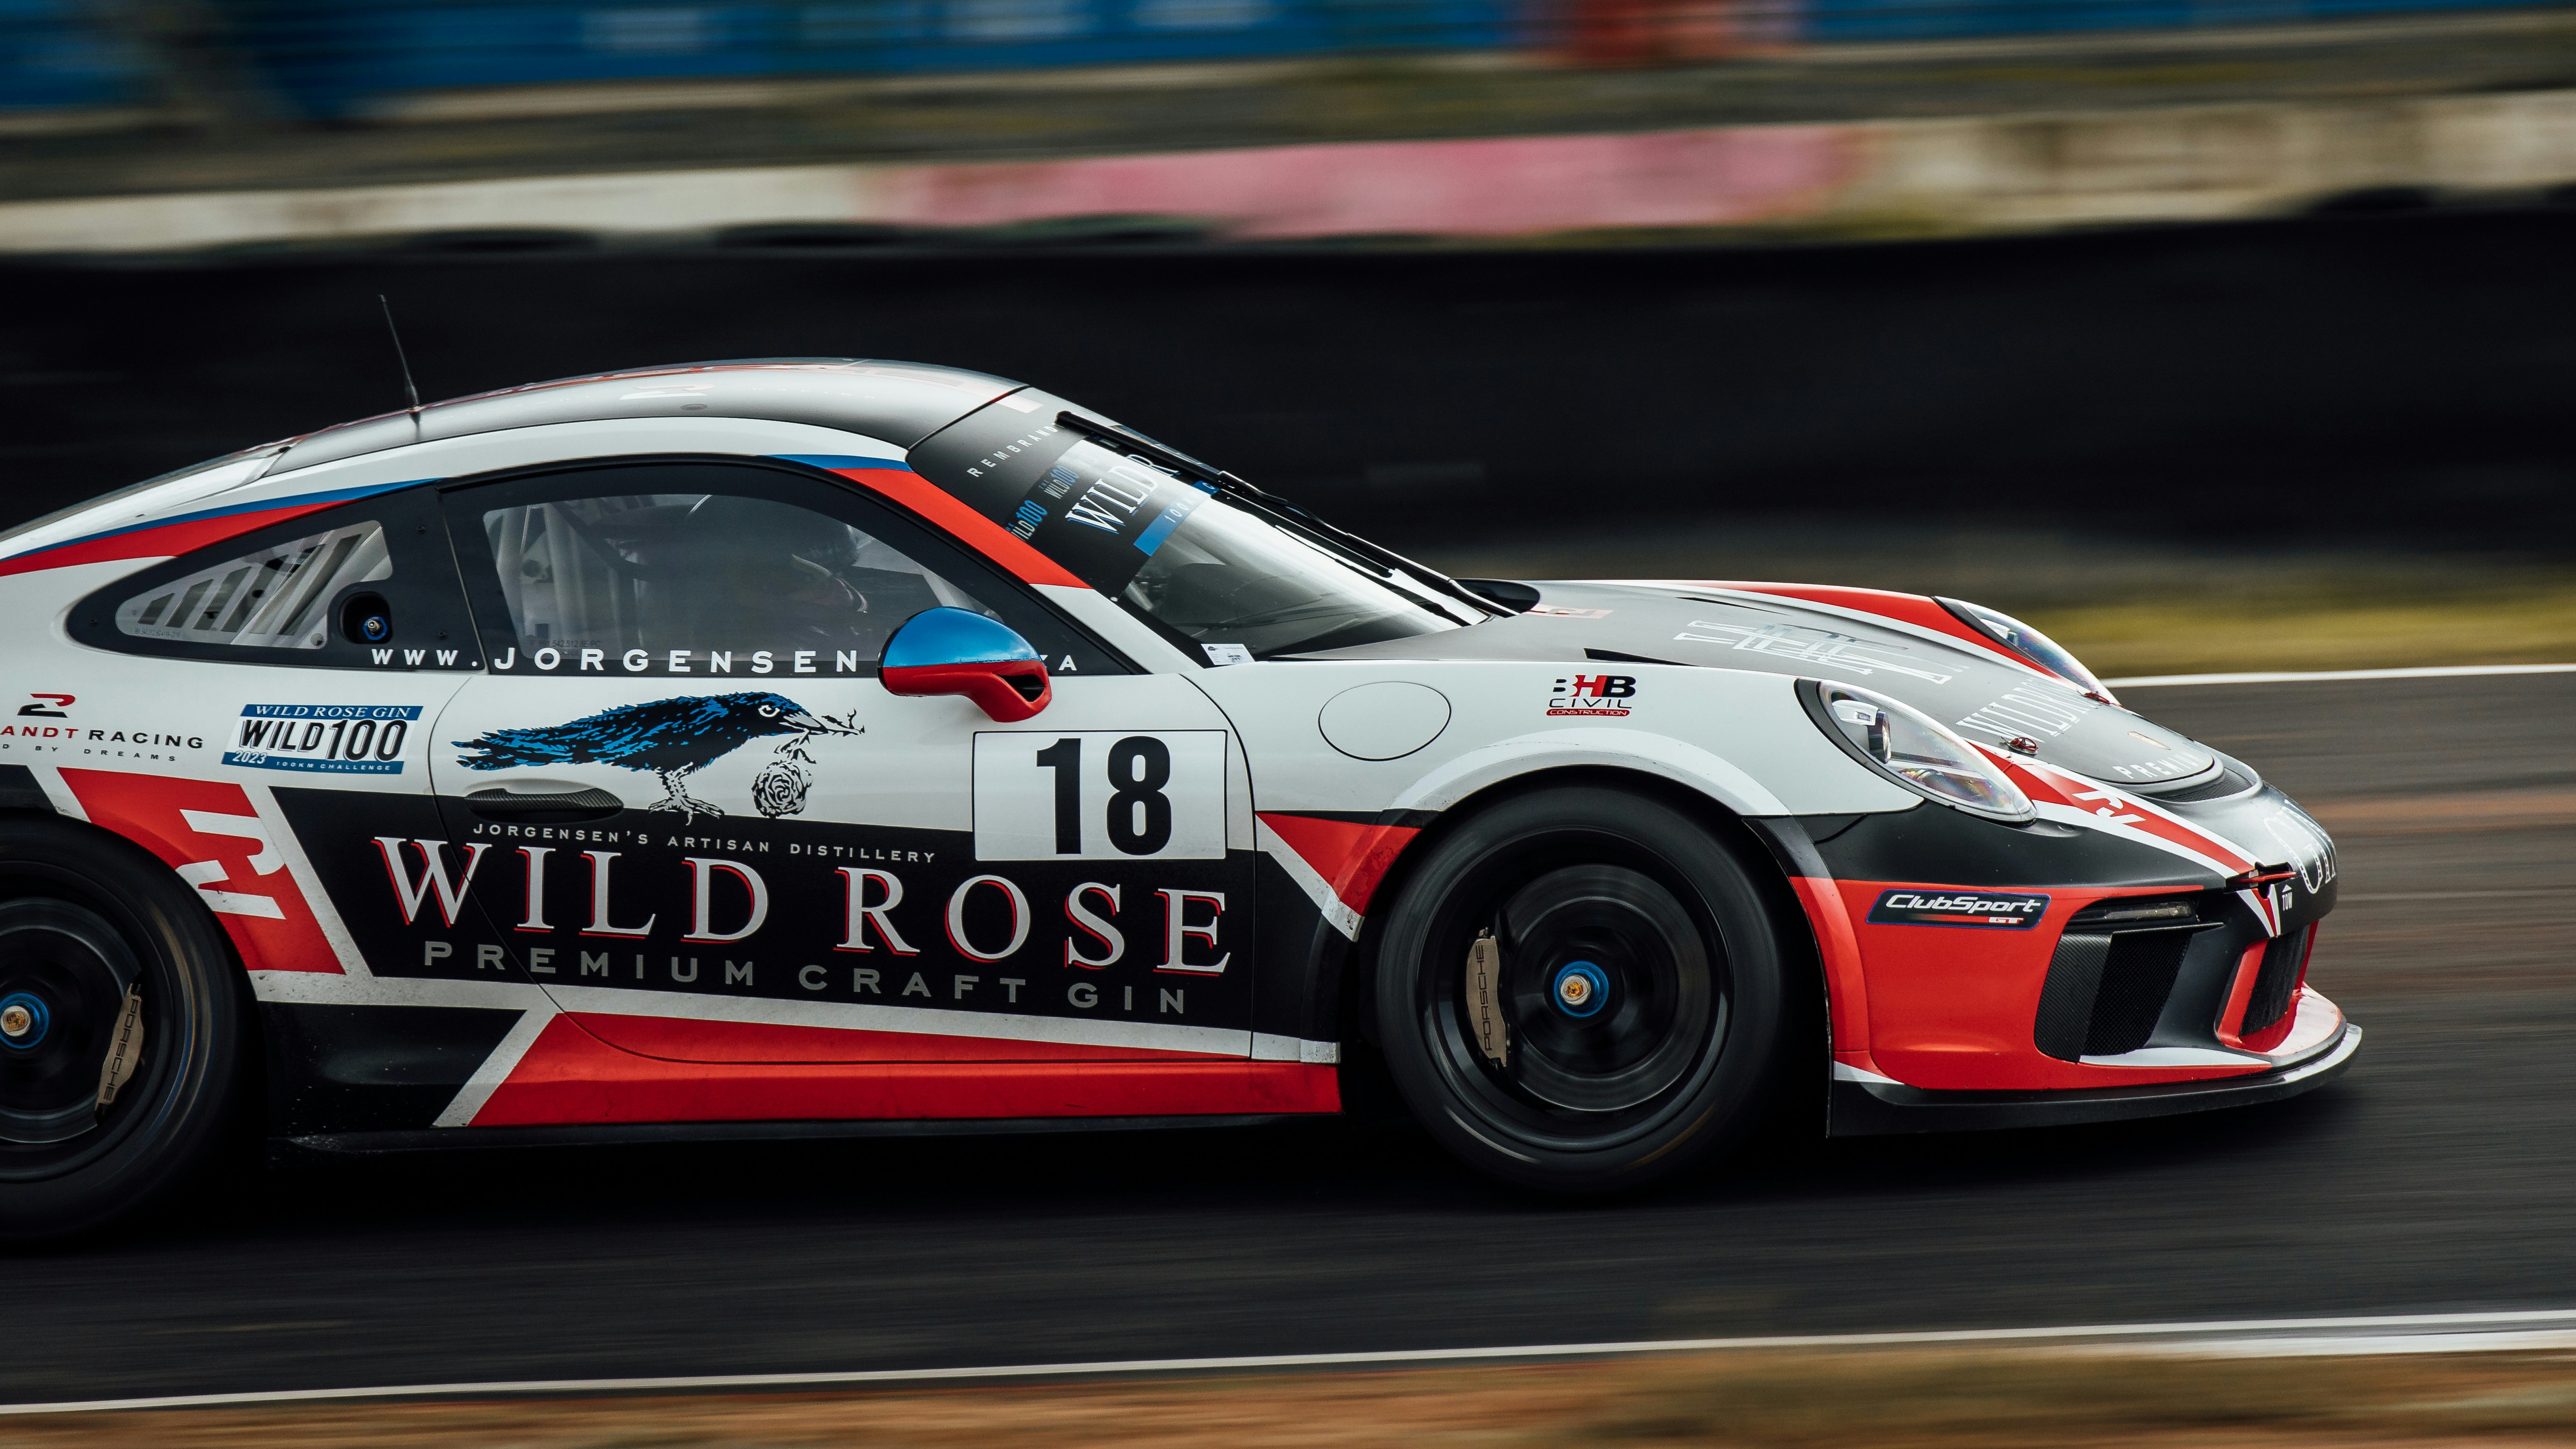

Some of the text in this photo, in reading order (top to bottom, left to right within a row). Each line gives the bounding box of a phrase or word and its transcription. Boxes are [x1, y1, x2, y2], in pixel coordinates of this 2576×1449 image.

[967, 423, 1059, 477] REMBRAND
[1065, 466, 1158, 534] WILD
[255, 706, 412, 718] WILD ROSE GIN
[1549, 698, 1632, 709] CIVIL
[88, 729, 203, 749] RACING
[83, 749, 175, 762] DREAMS
[232, 750, 268, 764] 2023
[1036, 735, 1172, 856] 18
[473, 823, 935, 863] JORGENSEN'S ARTISAN DISTILLERY
[371, 837, 1231, 976] WILD ROSE
[1886, 894, 2041, 914] ClubSport
[2282, 892, 2292, 911] TOW
[424, 941, 1183, 1014] PREMIUM CRAFT GIN
[1475, 944, 1493, 1051] PORSCHE
